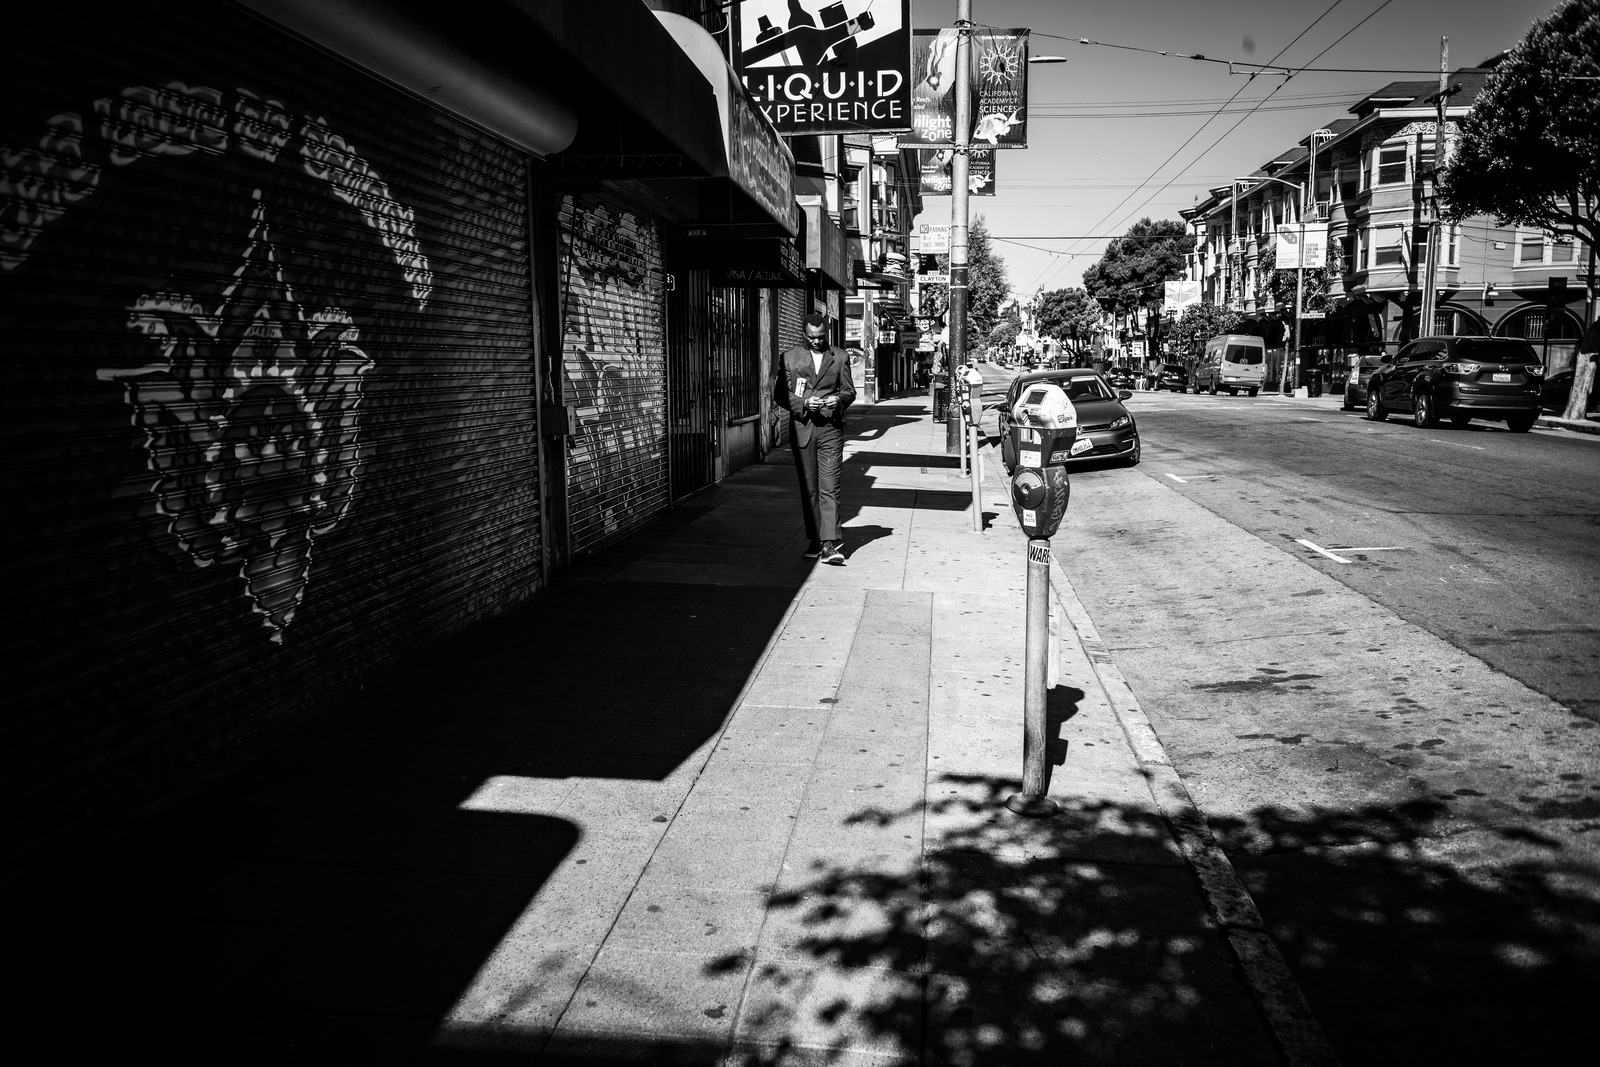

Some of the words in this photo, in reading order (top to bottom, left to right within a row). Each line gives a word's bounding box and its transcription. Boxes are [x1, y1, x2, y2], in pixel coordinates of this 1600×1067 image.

[759, 100, 902, 123] XPERIENCE
[979, 105, 1017, 113] SCIENCES
[913, 115, 952, 130] ilight
[921, 128, 952, 142] zone
[921, 175, 951, 185] twilight
[933, 183, 952, 191] zone
[920, 225, 929, 233] NO
[726, 269, 746, 279] VISA
